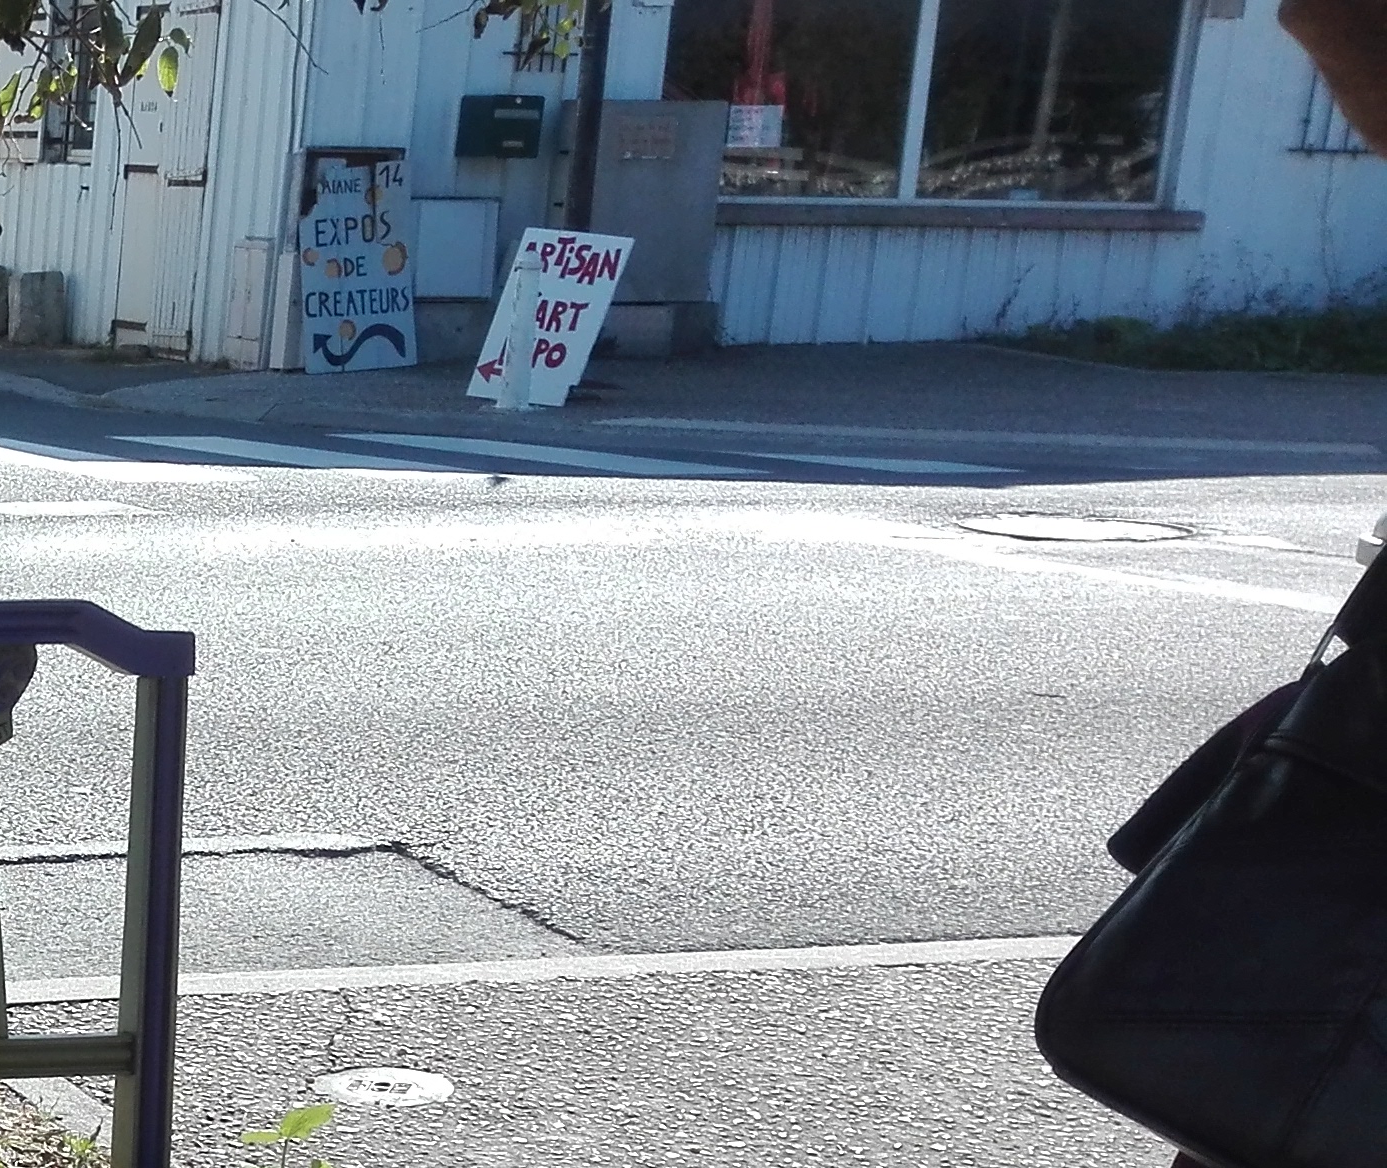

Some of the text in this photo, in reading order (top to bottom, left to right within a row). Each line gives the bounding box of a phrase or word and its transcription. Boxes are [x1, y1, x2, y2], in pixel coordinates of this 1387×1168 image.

[379, 163, 404, 189] 14
[315, 210, 392, 248] EXPOS
[343, 256, 368, 278] DE
[305, 286, 410, 318] CREATEURS
